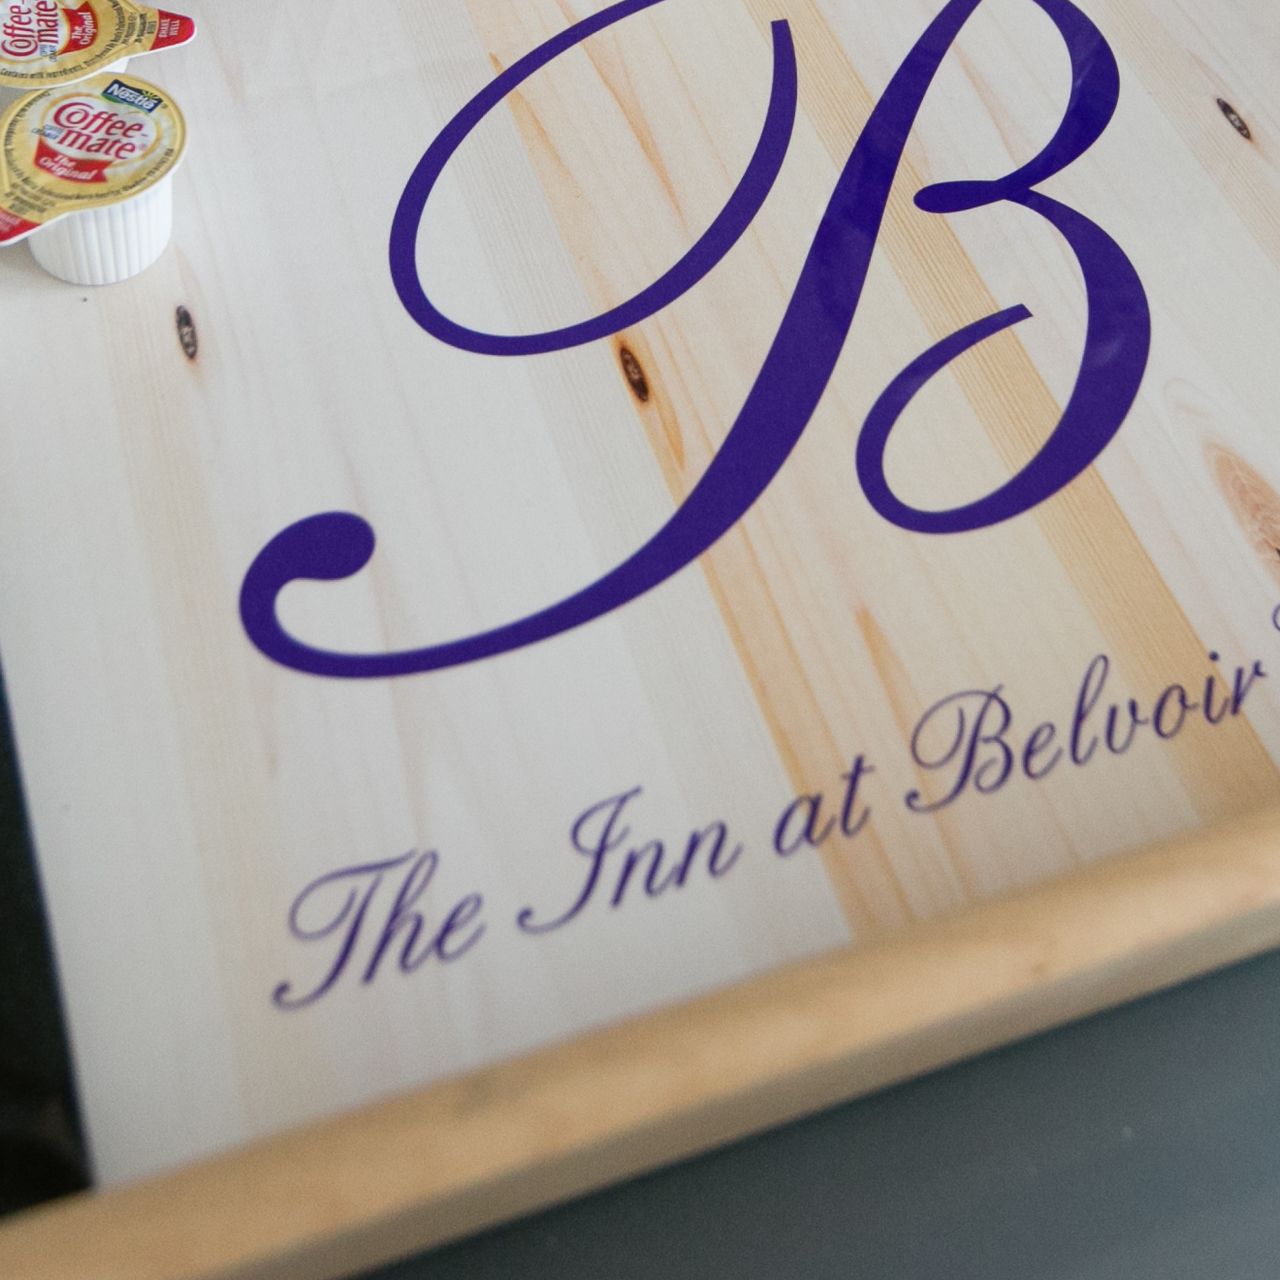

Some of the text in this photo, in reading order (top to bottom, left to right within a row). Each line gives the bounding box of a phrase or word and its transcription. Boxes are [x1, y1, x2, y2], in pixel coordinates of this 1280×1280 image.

[35, 0, 58, 47] mate
[72, 25, 82, 40] The
[80, 12, 92, 45] Original
[53, 101, 148, 137] Coffee-
[58, 129, 136, 159] mate
[40, 156, 98, 181] Original
[54, 154, 76, 167] The
[272, 849, 486, 1011] The
[516, 786, 743, 935] Inn
[773, 756, 874, 858] at
[904, 651, 1267, 814] Belvoir
